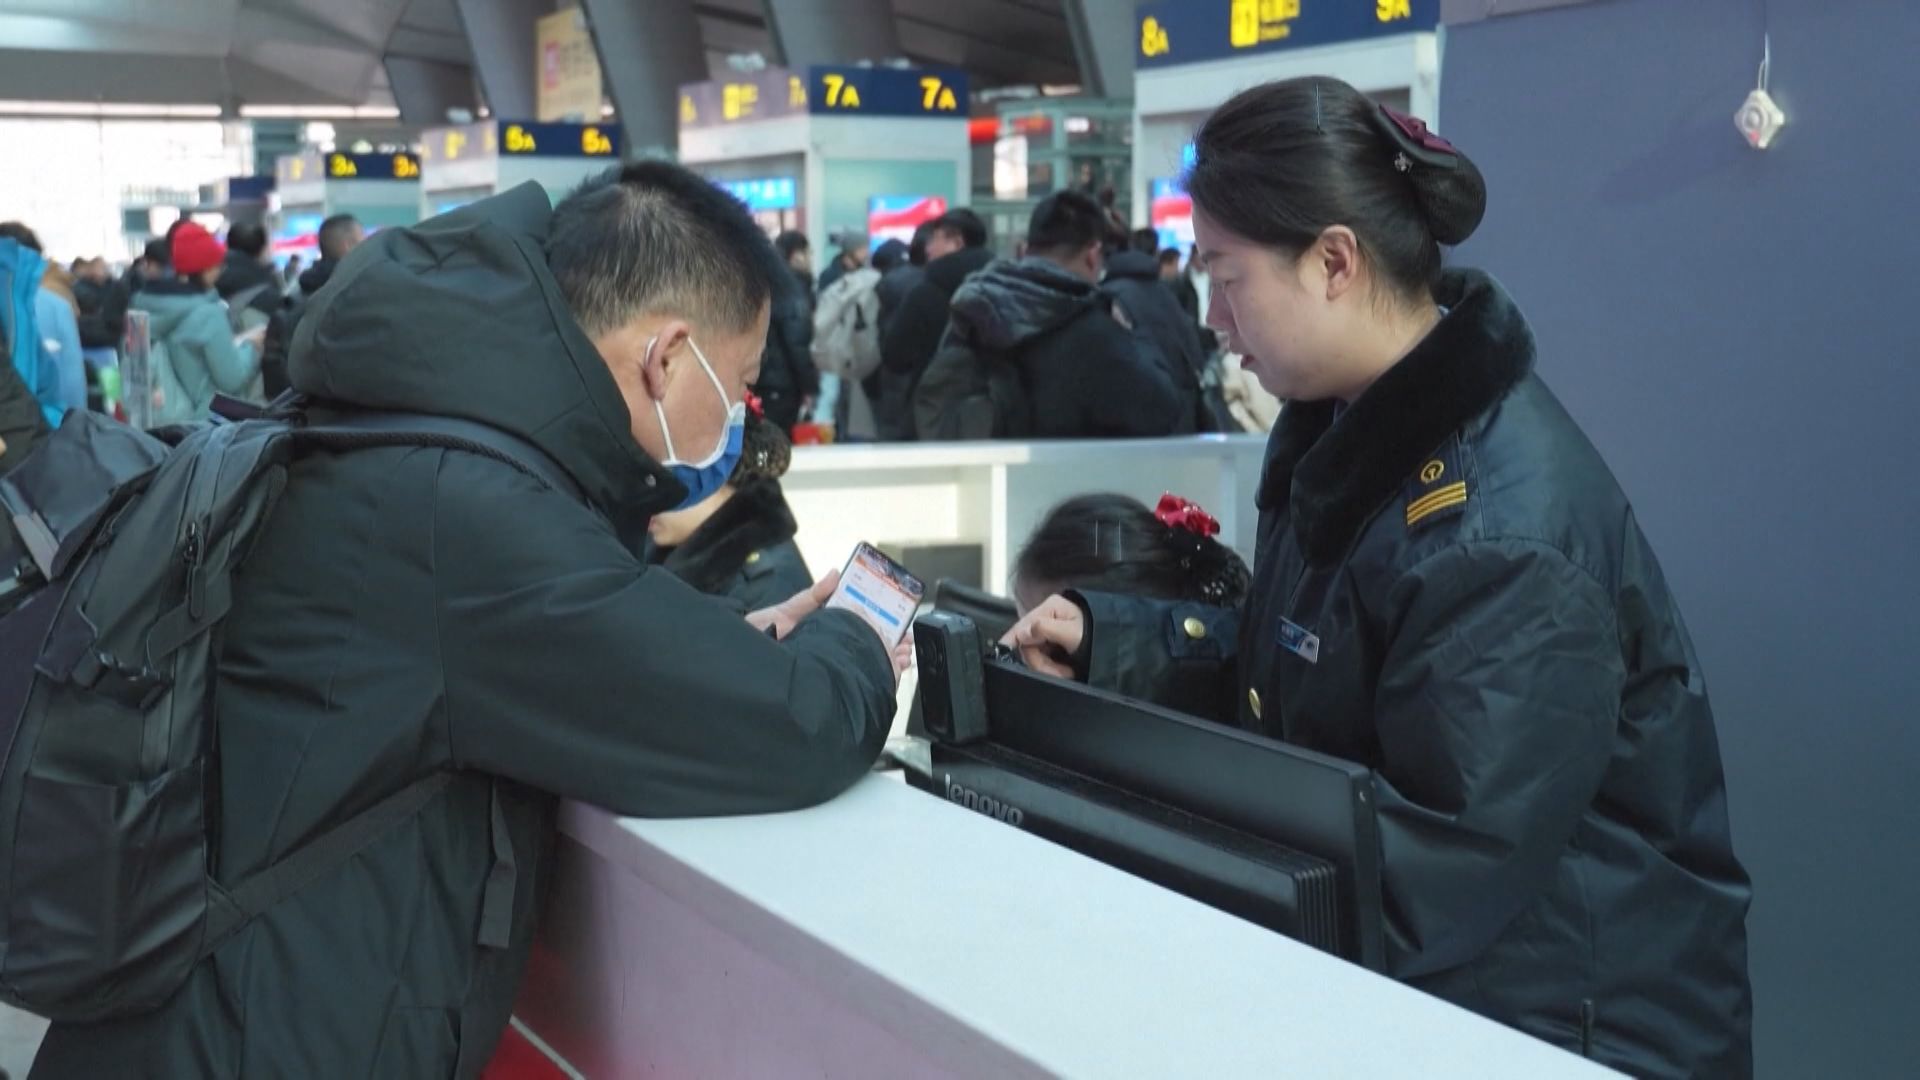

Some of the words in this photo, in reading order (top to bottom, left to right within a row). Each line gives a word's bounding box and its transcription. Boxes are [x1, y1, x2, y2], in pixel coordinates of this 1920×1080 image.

[1141, 17, 1168, 57] 8A
[824, 74, 860, 107] 7A
[920, 76, 956, 110] 7A
[505, 125, 535, 152] 5A
[581, 127, 611, 155] 5A
[945, 773, 1024, 825] lenovo
